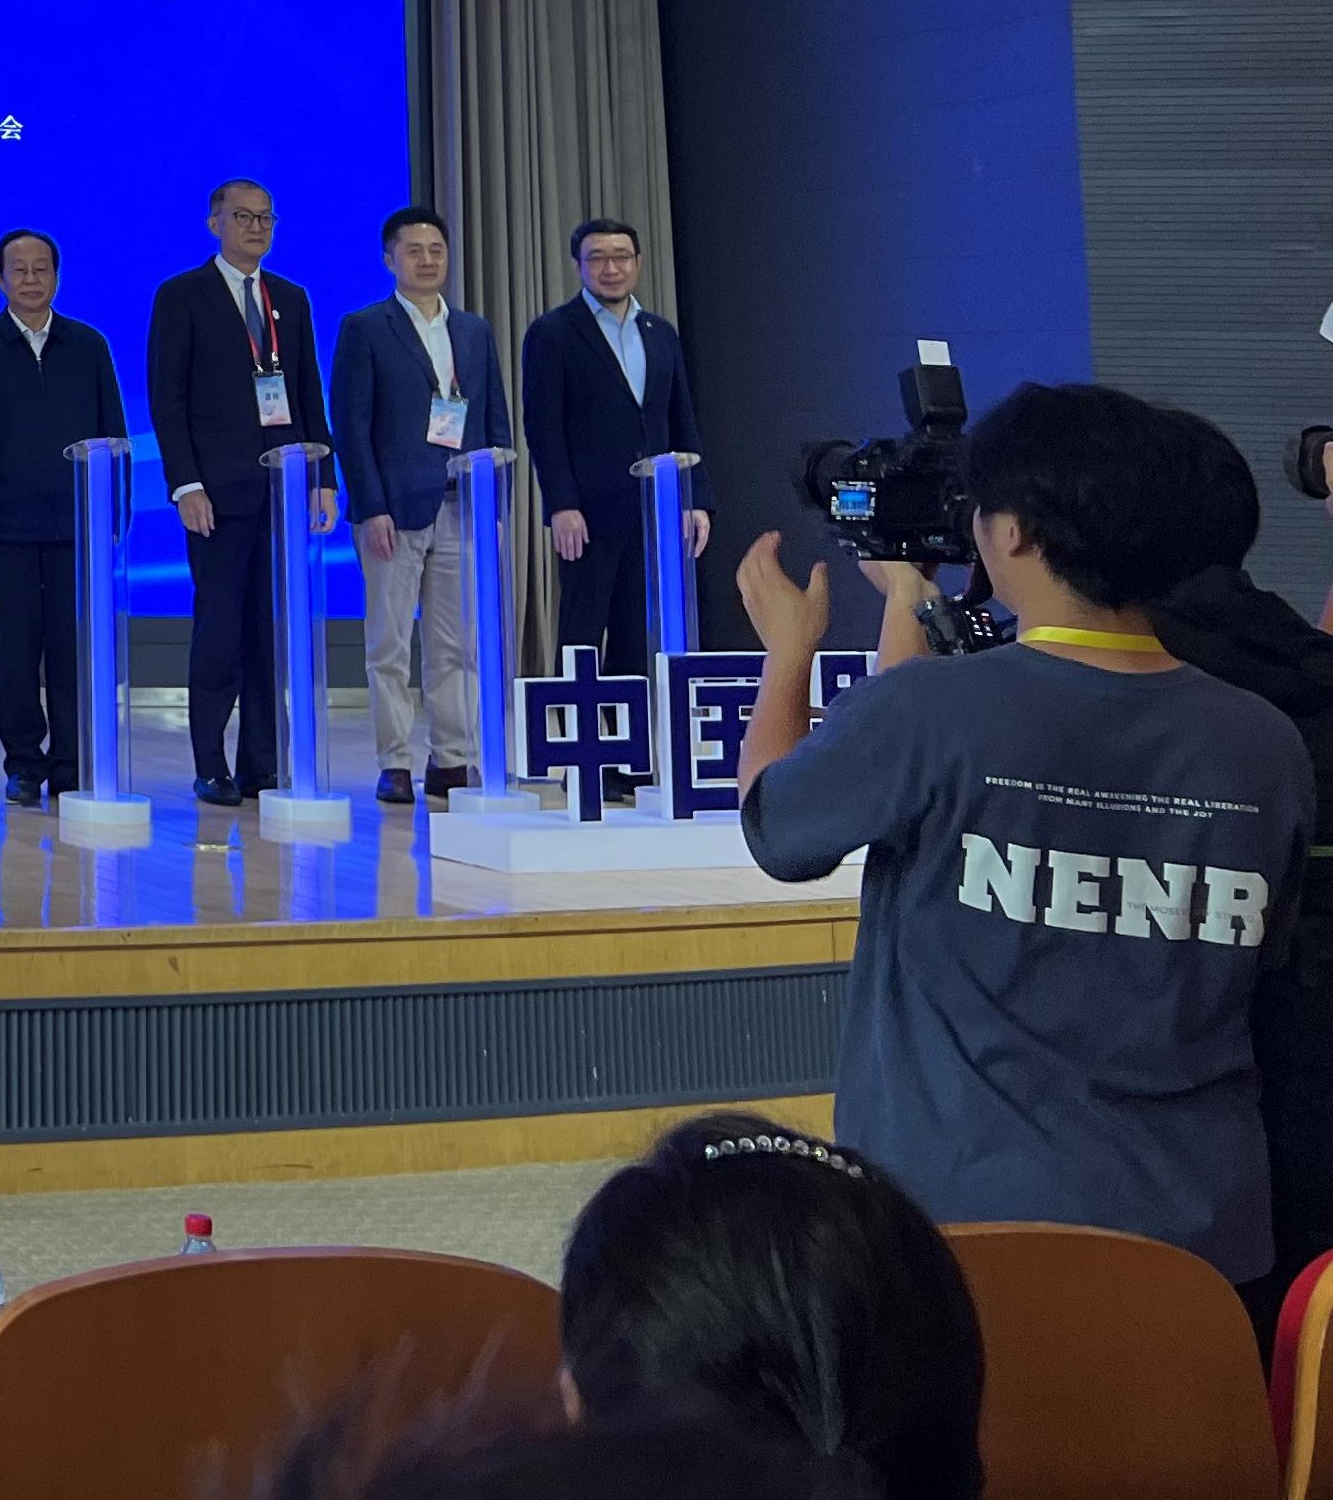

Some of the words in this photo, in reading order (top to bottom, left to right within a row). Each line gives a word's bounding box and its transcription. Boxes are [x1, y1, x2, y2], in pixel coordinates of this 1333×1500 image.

[514, 645, 878, 822] 中国
[985, 776, 1032, 789] FREEDOM
[1047, 783, 1064, 793] THE
[1067, 787, 1091, 797] REAL
[1094, 790, 1148, 802] AWAKENING
[1151, 795, 1170, 804] THE
[1173, 797, 1201, 807] REAL
[1204, 800, 1259, 813] LIBERATION
[1038, 794, 1063, 803] FROM
[1066, 797, 1093, 808] MANY
[1096, 801, 1141, 813] ILLUSIONS
[1145, 805, 1165, 814] AND
[1169, 807, 1189, 816] THE
[1193, 810, 1213, 819] JOY
[959, 834, 1269, 947] NENR
